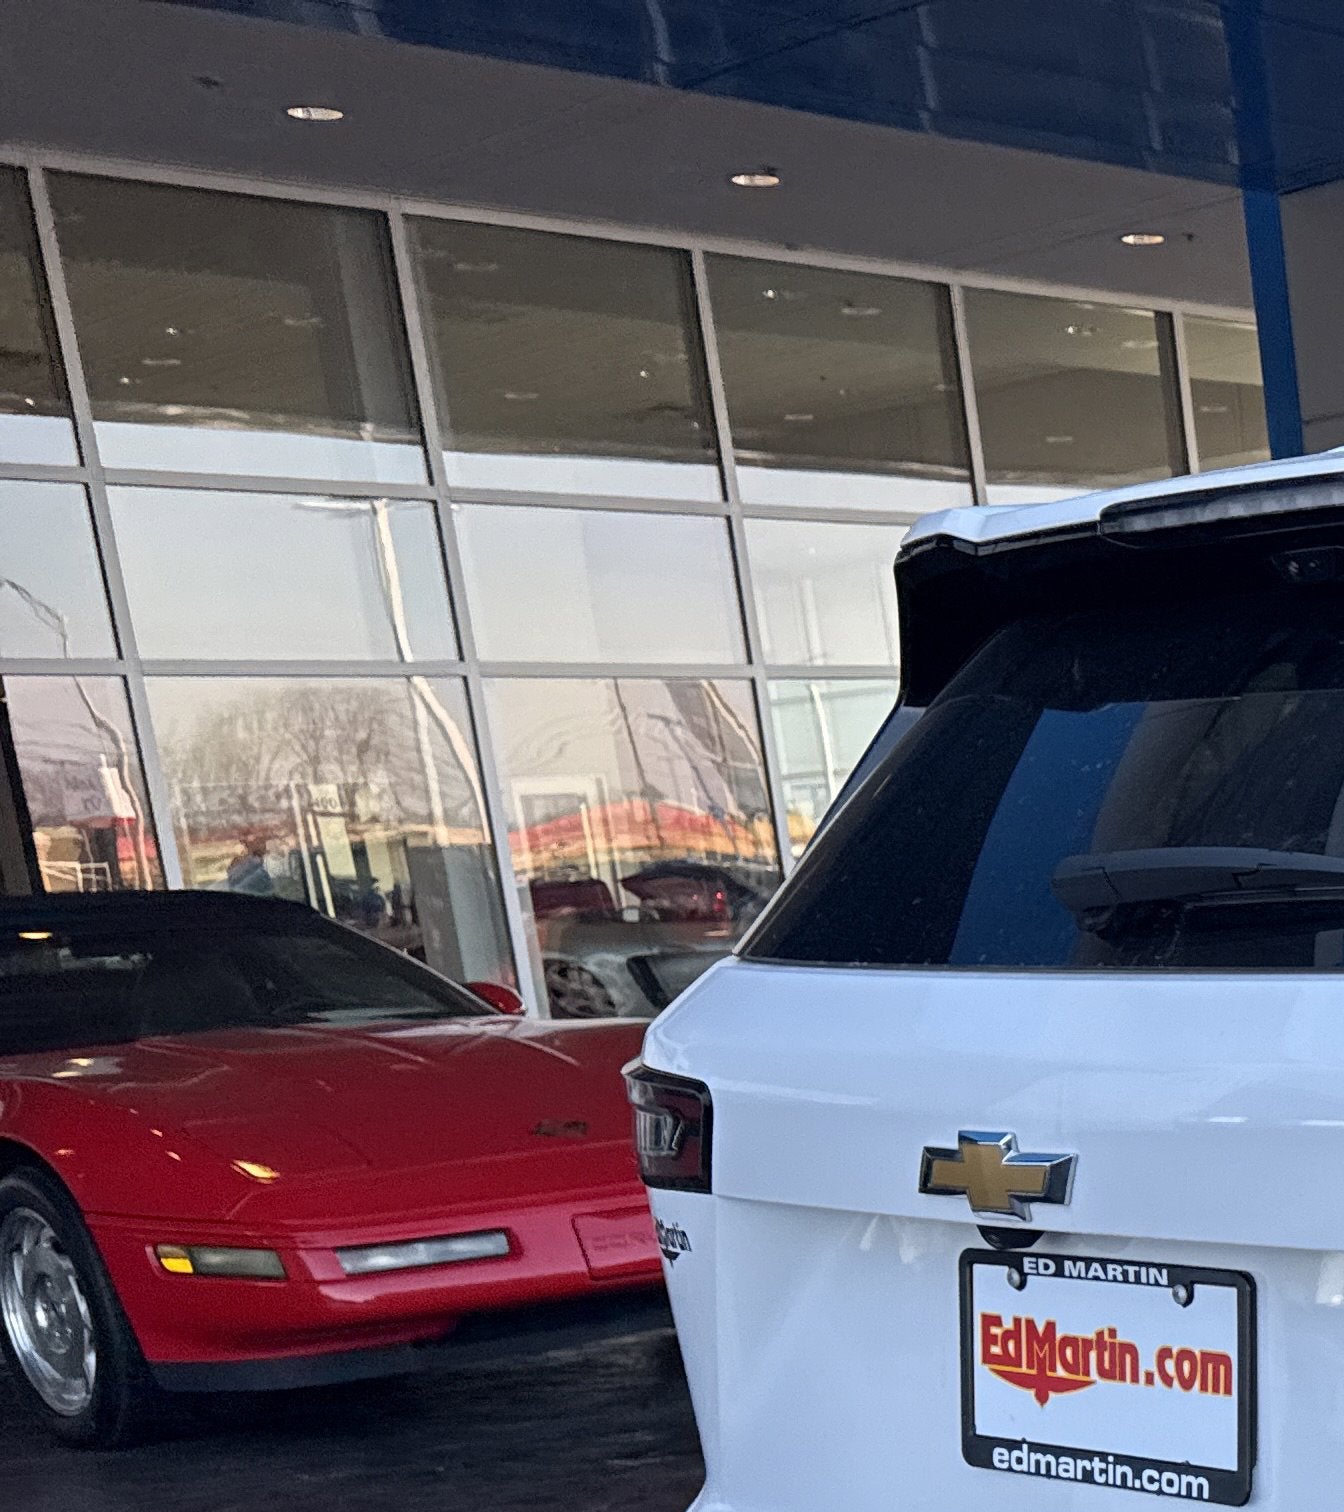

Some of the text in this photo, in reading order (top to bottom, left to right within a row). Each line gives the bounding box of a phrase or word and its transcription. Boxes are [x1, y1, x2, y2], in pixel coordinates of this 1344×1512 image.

[1022, 1257, 1169, 1286] ED MARTIN
[980, 1311, 1234, 1398] EdMartin.com
[992, 1443, 1210, 1499] edmartin.com
